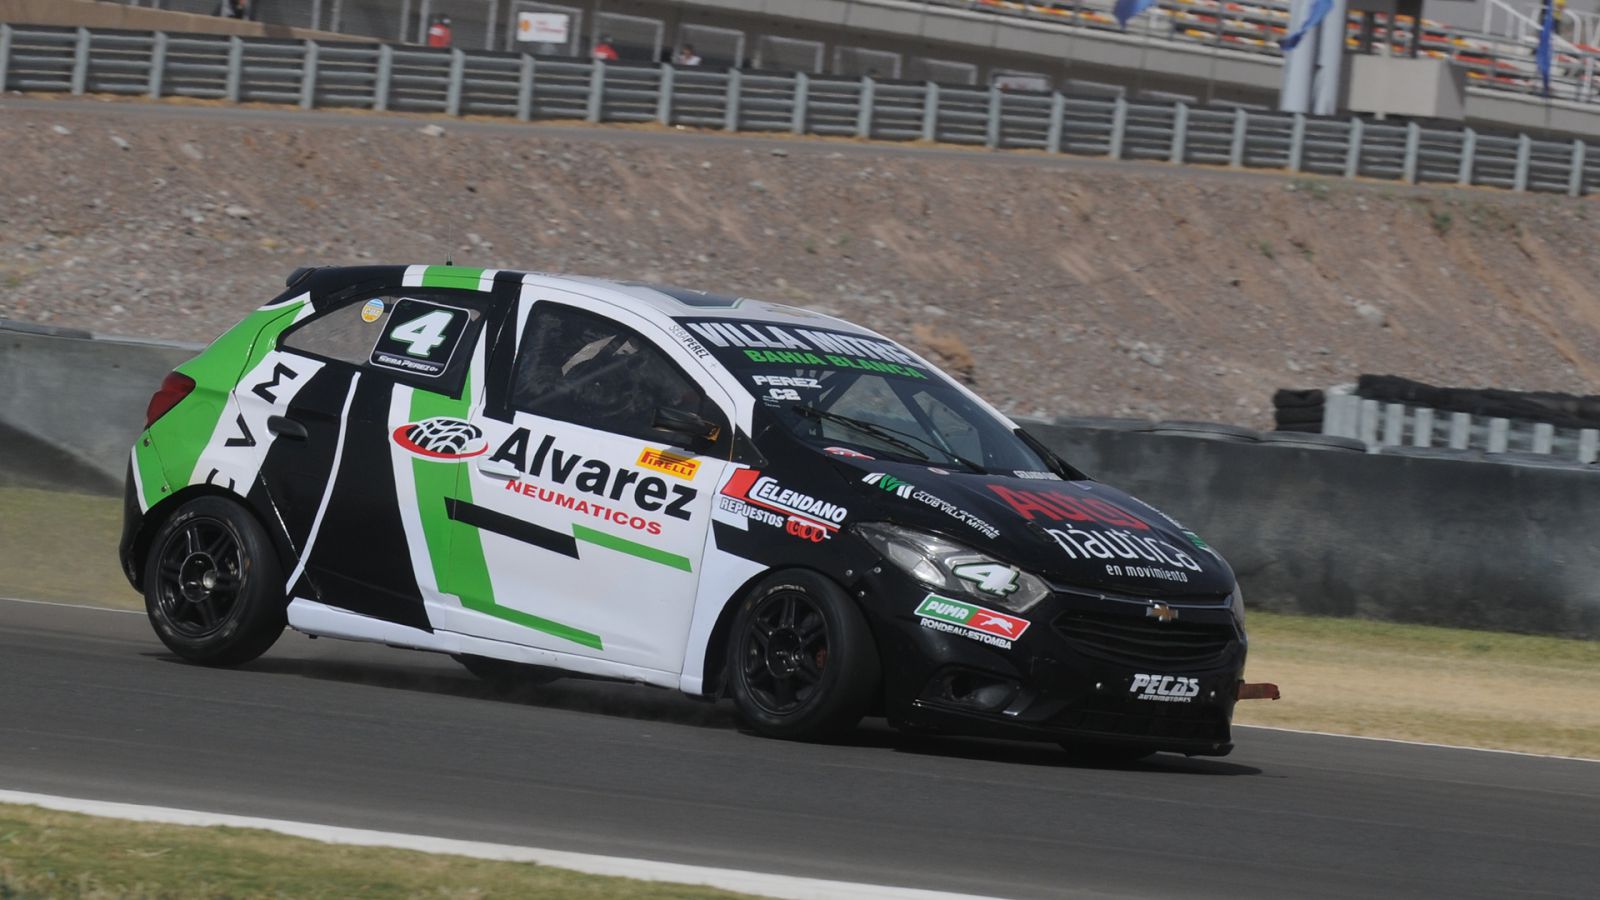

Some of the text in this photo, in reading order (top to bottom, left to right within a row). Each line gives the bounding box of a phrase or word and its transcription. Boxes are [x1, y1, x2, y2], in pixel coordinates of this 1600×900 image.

[390, 310, 454, 357] 4
[686, 322, 928, 370] VILLA MITRE
[743, 349, 928, 380] BAHIA BLANCA
[752, 375, 822, 388] PEREZ
[769, 388, 801, 400] C2
[488, 427, 699, 521] Alvarez
[640, 451, 697, 476] PIRELLI
[505, 479, 662, 535] NEUMATICOS
[719, 496, 785, 528] REPUESTOS
[912, 491, 998, 540] CLUB VILLA MITRE
[959, 510, 1000, 536] OFICIAL
[955, 565, 1019, 596] 4
[1106, 563, 1188, 583] en movimiento
[925, 600, 970, 620] PUMA
[919, 617, 1012, 650] RONDEAU-ESTOMBA
[1129, 673, 1200, 697] PECAS
